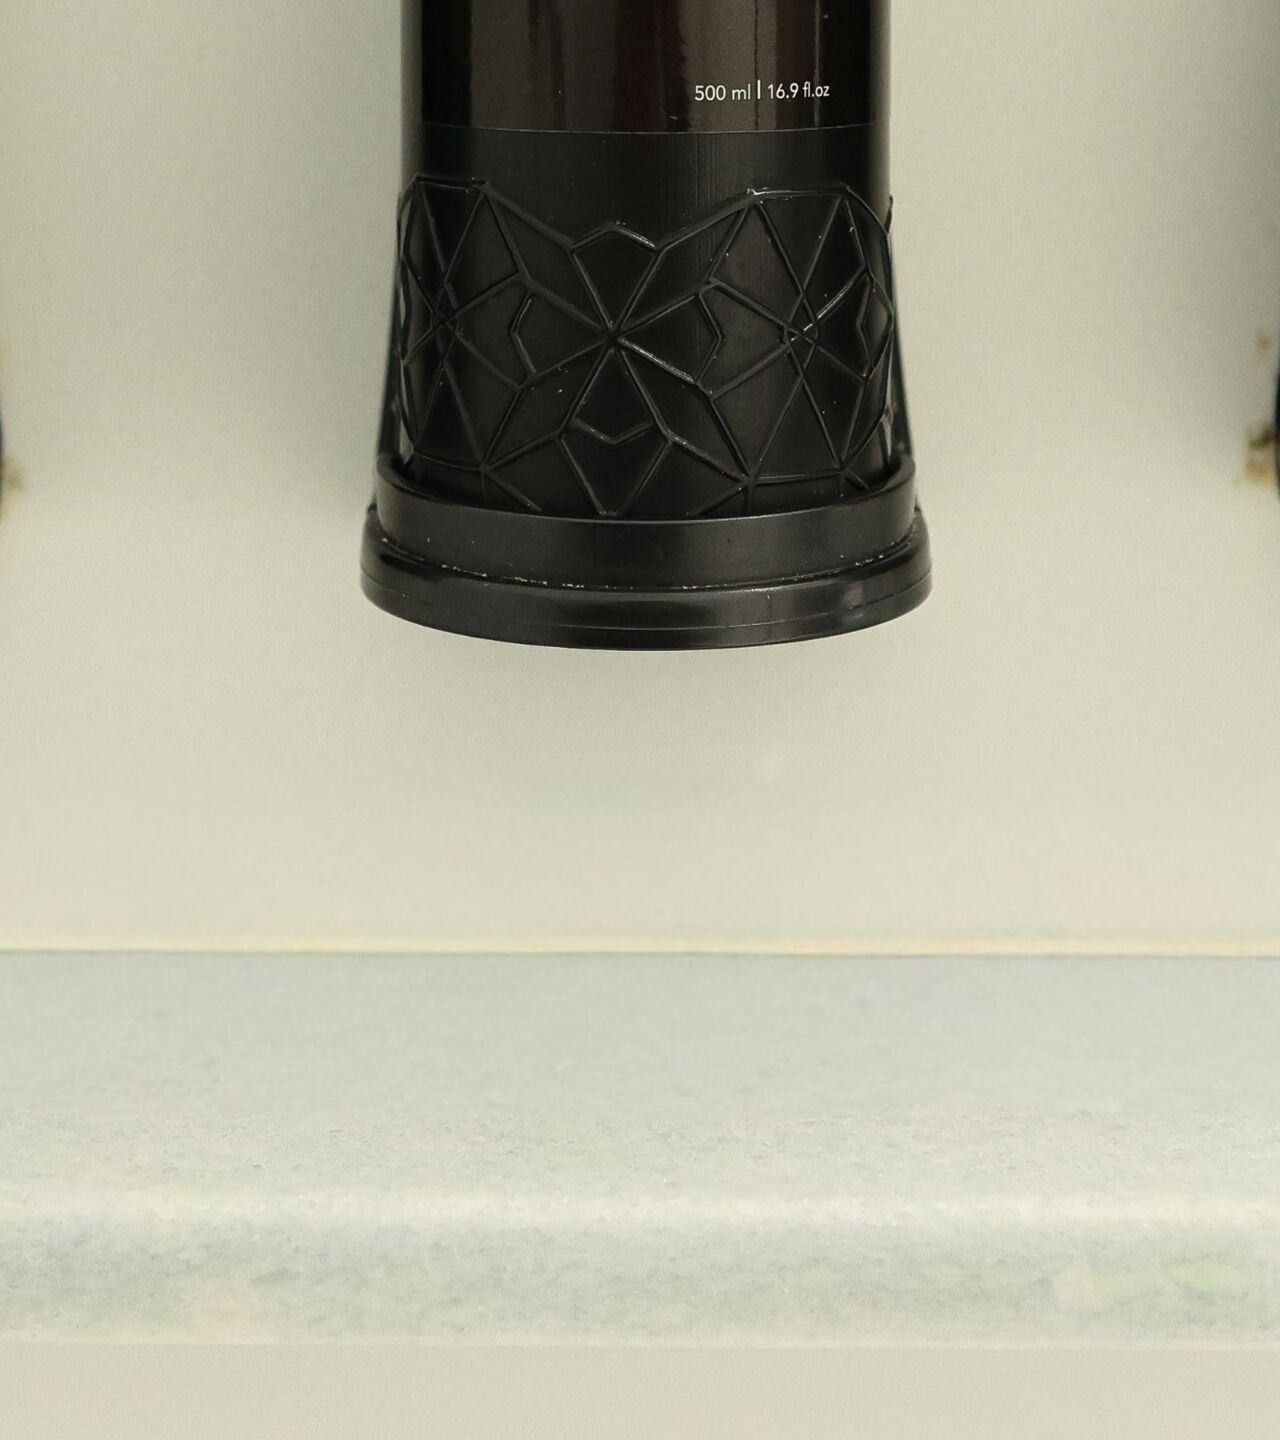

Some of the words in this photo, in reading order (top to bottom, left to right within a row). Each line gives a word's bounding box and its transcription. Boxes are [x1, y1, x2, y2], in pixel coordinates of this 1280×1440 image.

[694, 84, 726, 101] 500
[731, 83, 751, 100] ml
[767, 82, 799, 99] 16.9
[802, 81, 830, 98] fl.oz
